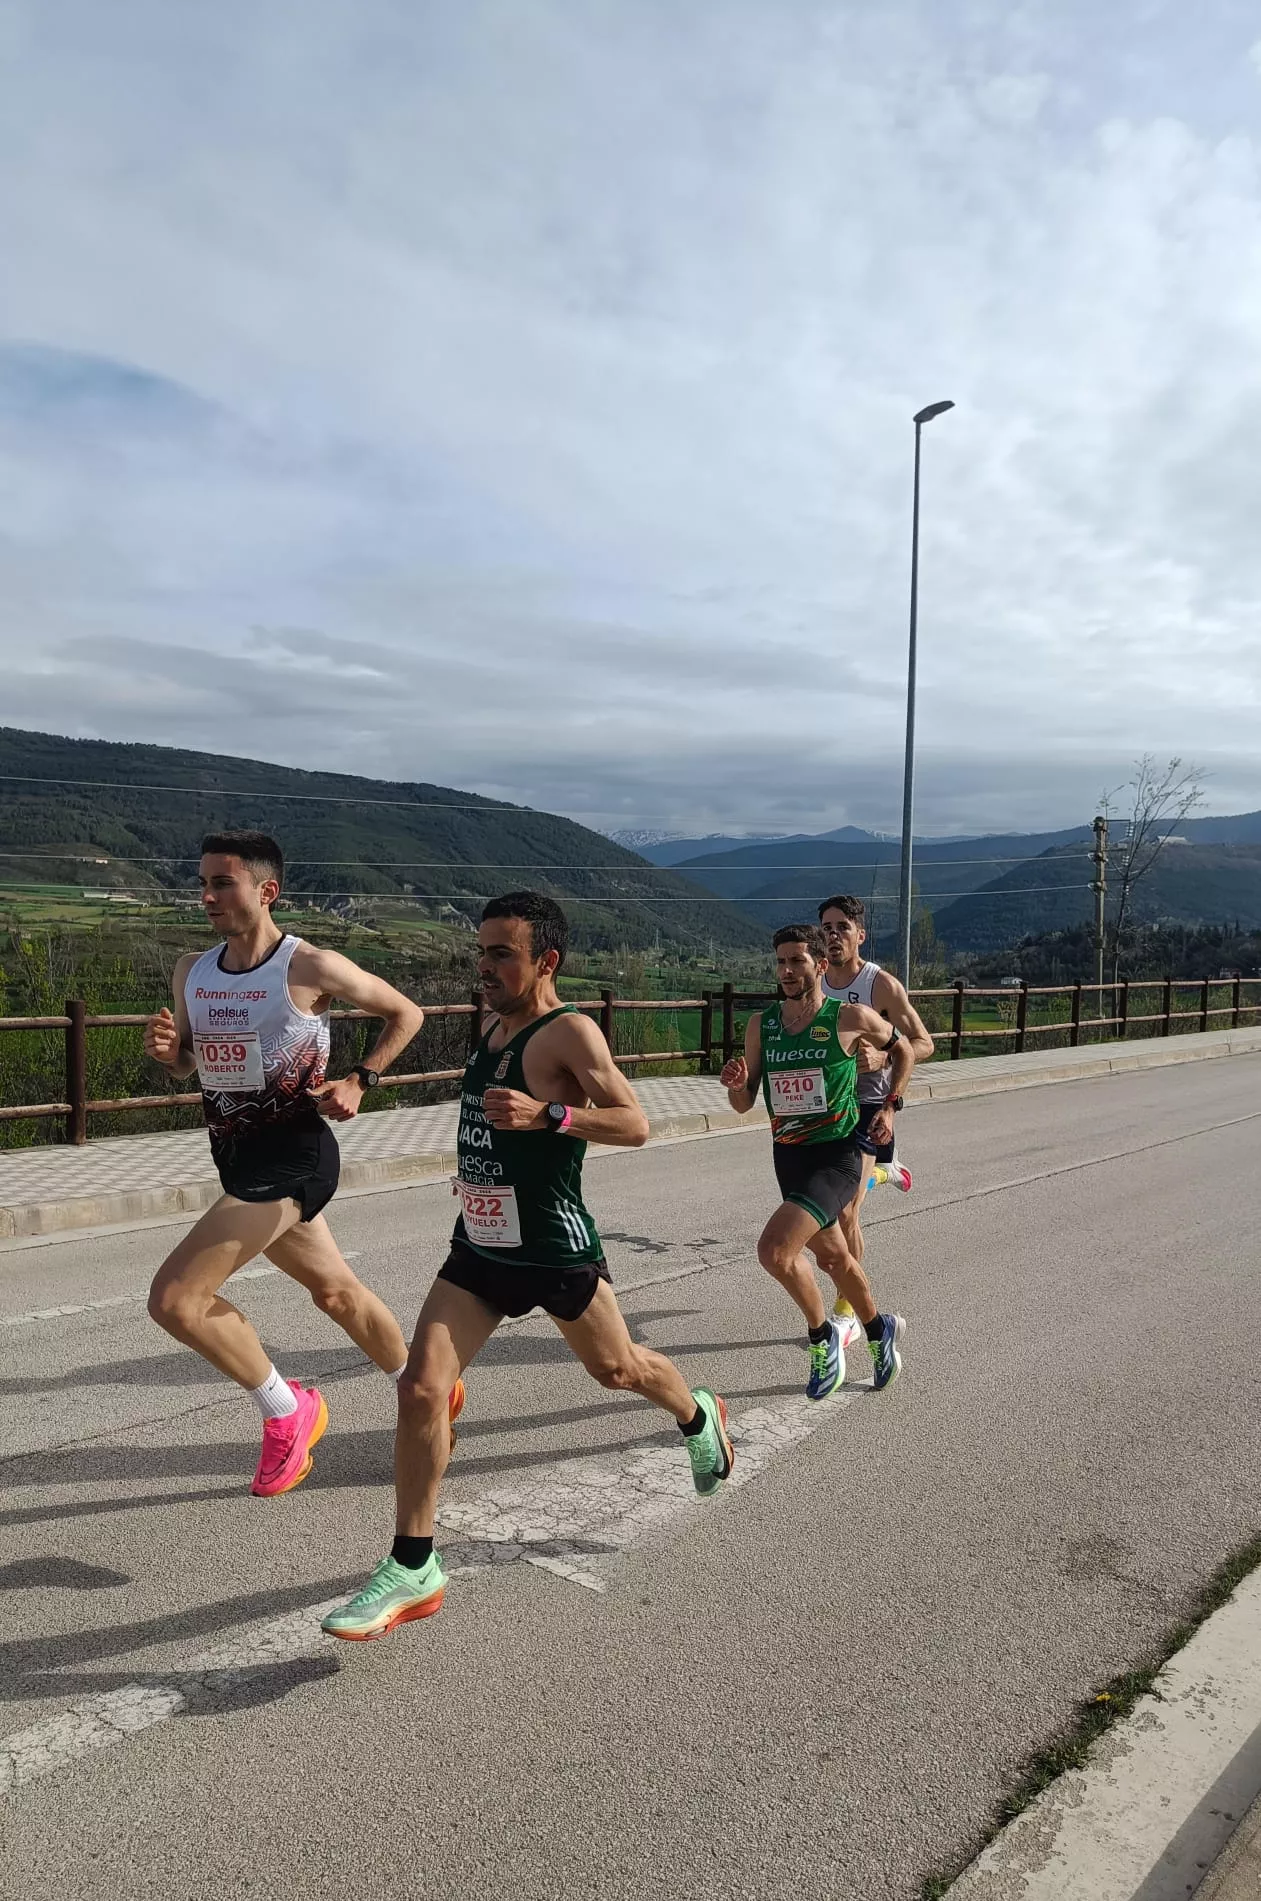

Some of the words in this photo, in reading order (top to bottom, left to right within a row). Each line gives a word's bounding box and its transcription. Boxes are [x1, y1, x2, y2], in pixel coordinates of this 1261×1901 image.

[200, 1044, 247, 1062] 1039
[766, 1048, 827, 1063] Huesca
[774, 1078, 814, 1094] 1210
[501, 1219, 509, 1228] 2
